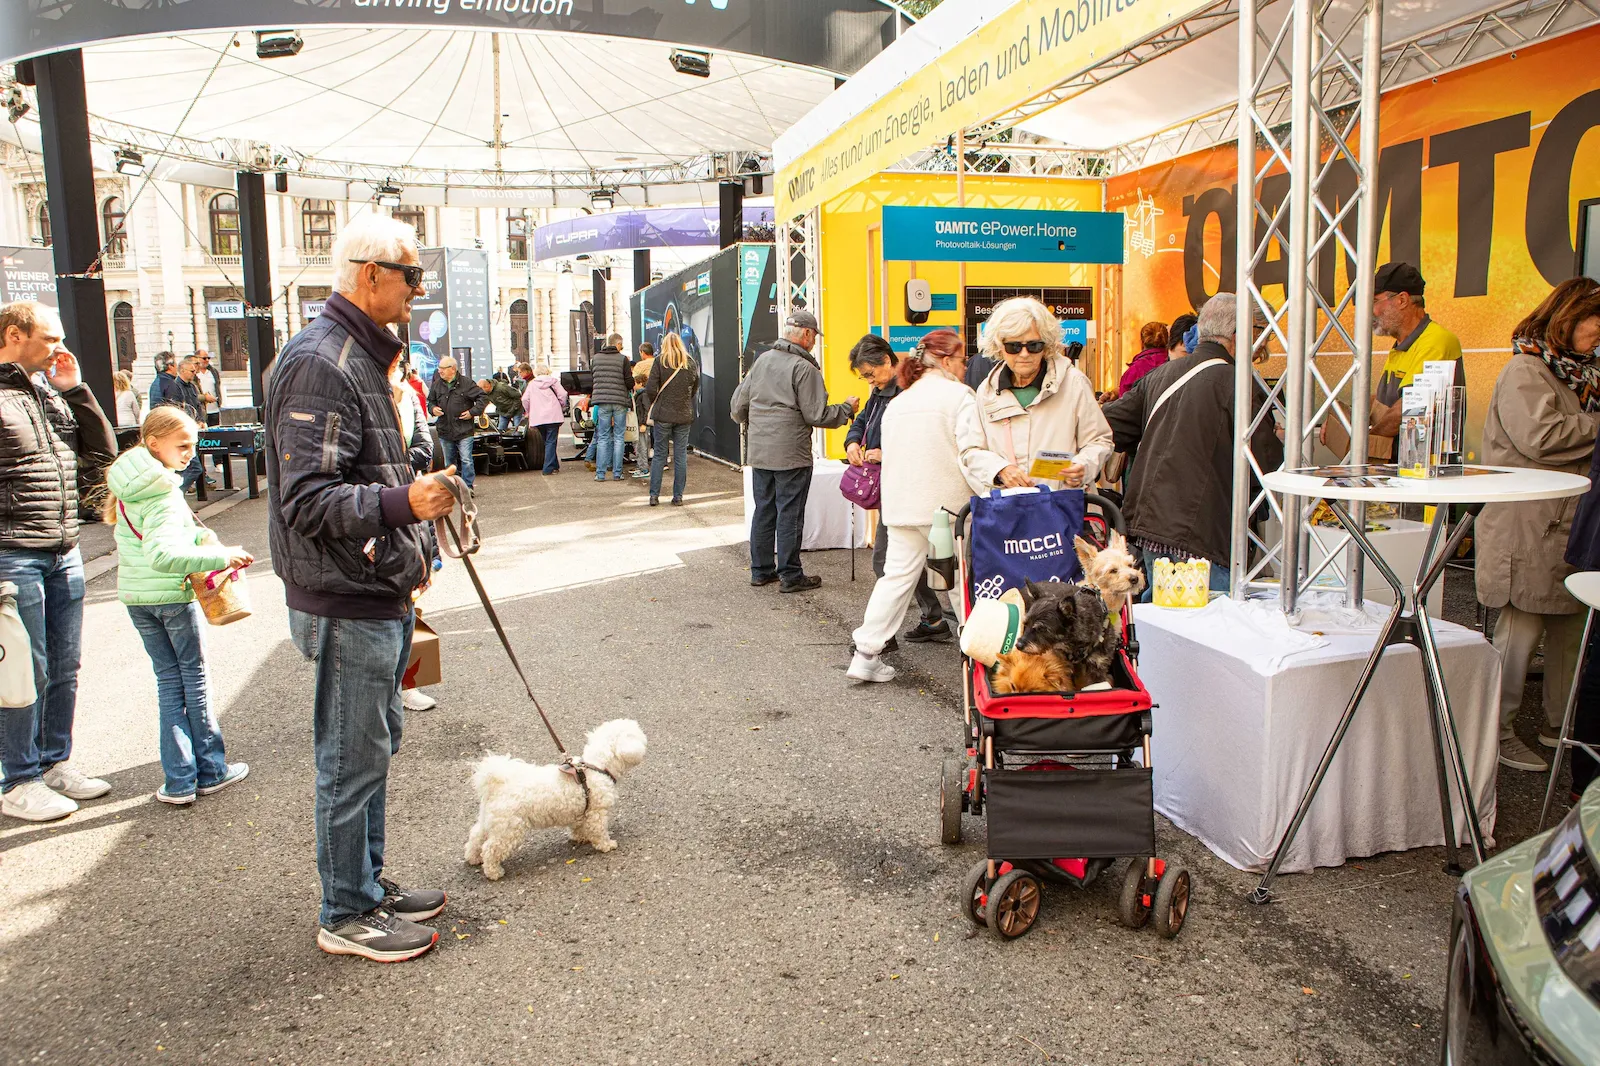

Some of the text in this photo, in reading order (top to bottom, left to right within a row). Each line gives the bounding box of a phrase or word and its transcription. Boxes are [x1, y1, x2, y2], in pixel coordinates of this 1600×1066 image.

[459, 0, 573, 16] emotion
[820, 156, 839, 184] Alles
[840, 136, 863, 172] rund
[864, 128, 883, 155] um
[884, 97, 934, 145] Energie,
[939, 65, 989, 112] Laden
[996, 25, 1031, 80] und
[935, 220, 1077, 238] ÖAMTC ePower.Home
[555, 228, 599, 244] CUPRA
[935, 239, 1017, 251] Photovoltaik-Lösungen
[5, 270, 50, 281] WIENER
[6, 281, 57, 292] ELEKTRO
[8, 291, 38, 301] TAGE
[213, 305, 239, 314] ALLES
[1055, 305, 1085, 315] Sonne
[1029, 552, 1049, 561] MAGIC
